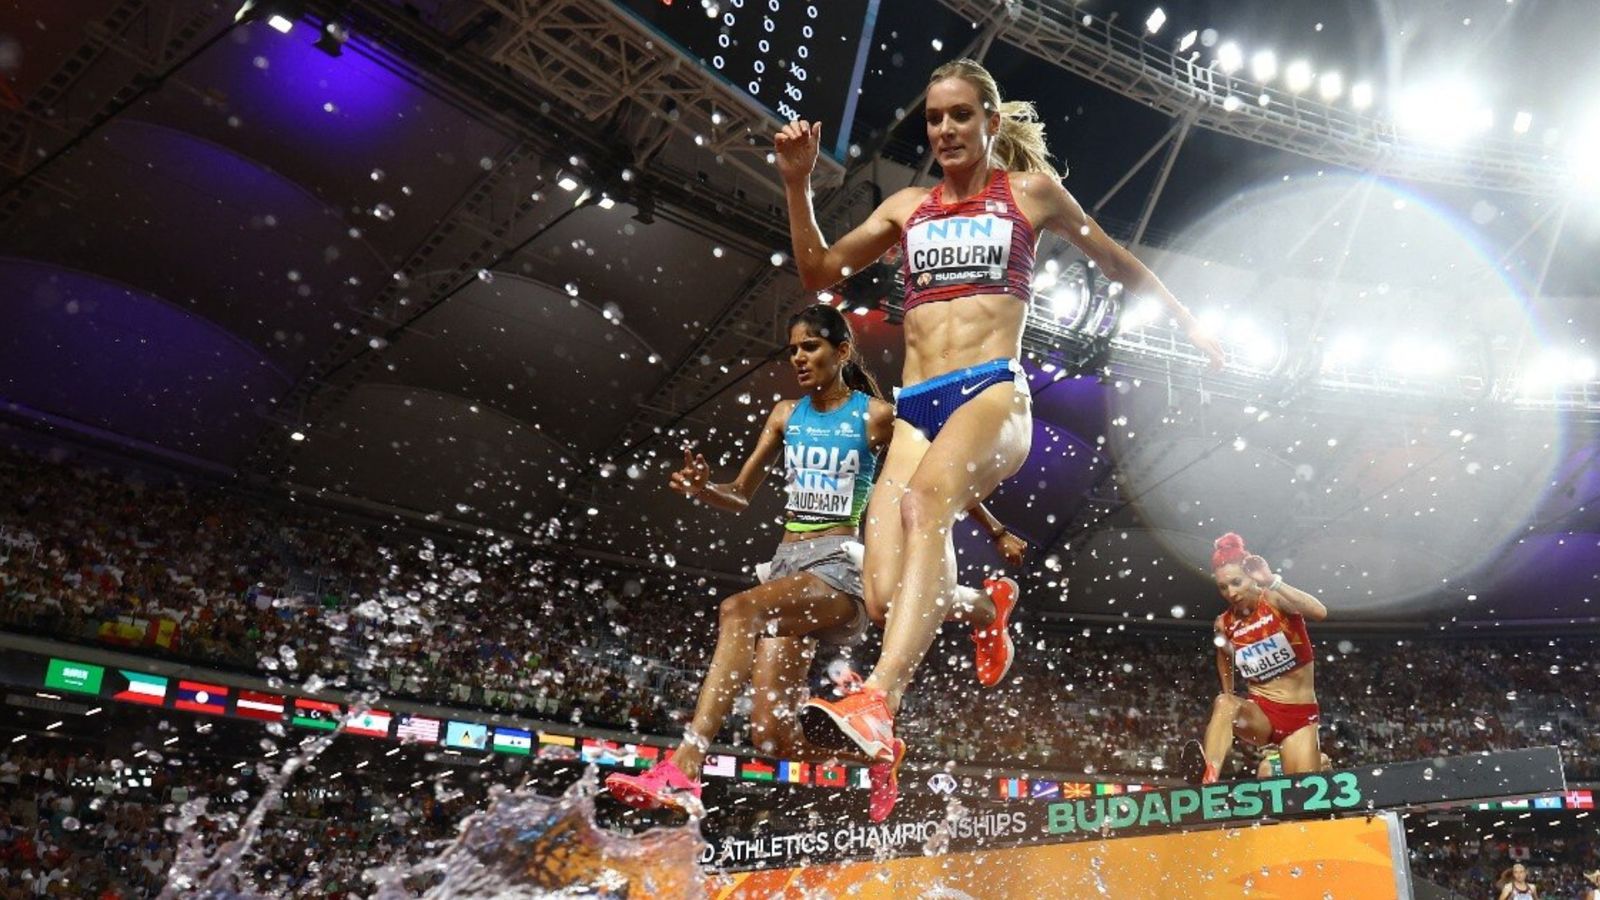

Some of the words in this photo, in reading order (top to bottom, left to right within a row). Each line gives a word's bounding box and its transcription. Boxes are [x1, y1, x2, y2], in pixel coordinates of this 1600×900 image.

[926, 218, 993, 240] NTN
[914, 245, 1004, 271] COBURN
[784, 445, 860, 475] NDIA
[1241, 637, 1278, 660] NTN
[1047, 779, 1291, 835] BUDAPEST
[1302, 773, 1361, 811] 23
[721, 830, 829, 861] ATHLETICS
[834, 812, 1027, 850] CHAMPIONSHIPS
